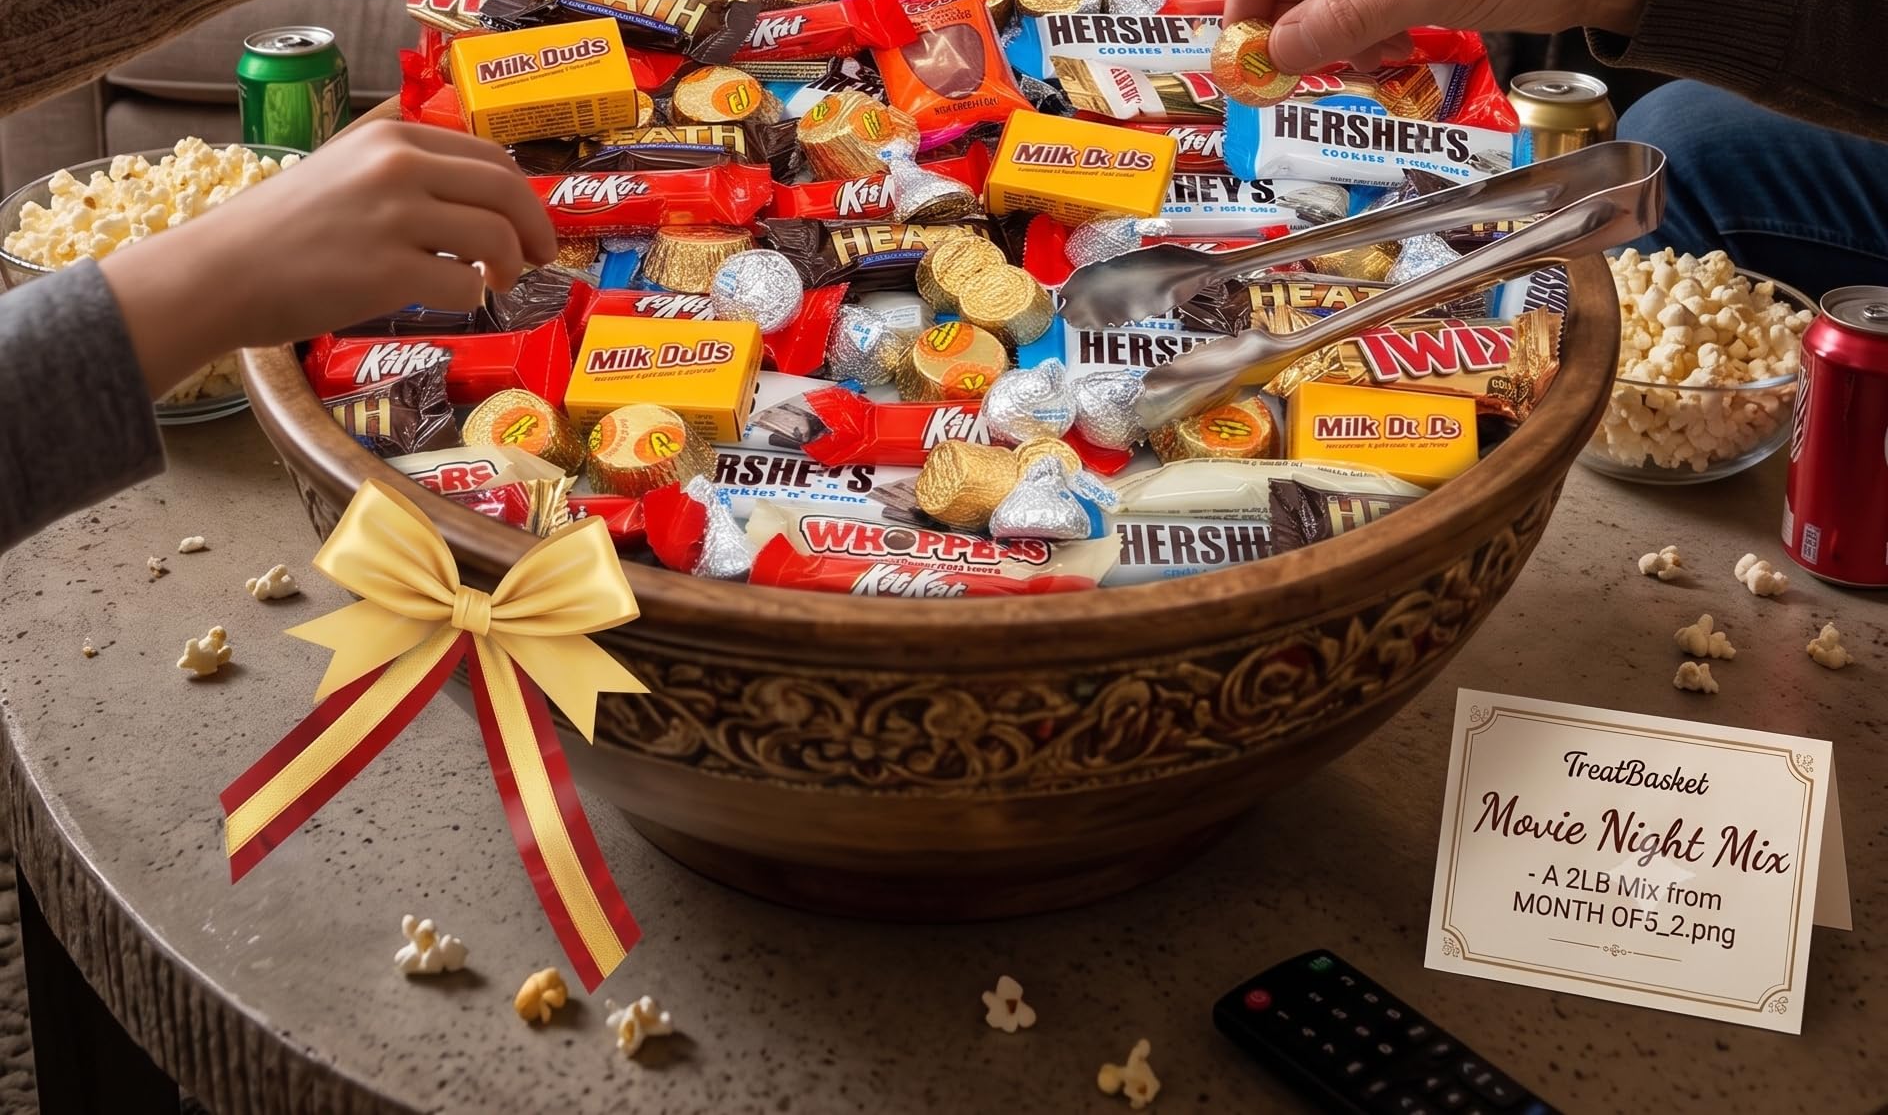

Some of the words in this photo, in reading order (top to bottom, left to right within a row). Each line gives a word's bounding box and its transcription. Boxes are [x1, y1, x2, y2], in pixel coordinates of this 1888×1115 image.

[475, 52, 538, 85] Milk
[539, 37, 612, 69] Duds
[1012, 143, 1078, 166] Milk
[585, 346, 655, 374] Milk
[1313, 415, 1380, 440] Milk
[1563, 750, 1710, 796] TreatBasket
[1473, 791, 1588, 846] Movie
[1597, 808, 1706, 868] Night
[1711, 825, 1791, 876] Mix
[1541, 864, 1559, 887] A
[1565, 867, 1612, 894] 2LB
[1617, 875, 1661, 902] Mix
[1666, 882, 1723, 911] from
[1512, 891, 1605, 925] MONTH
